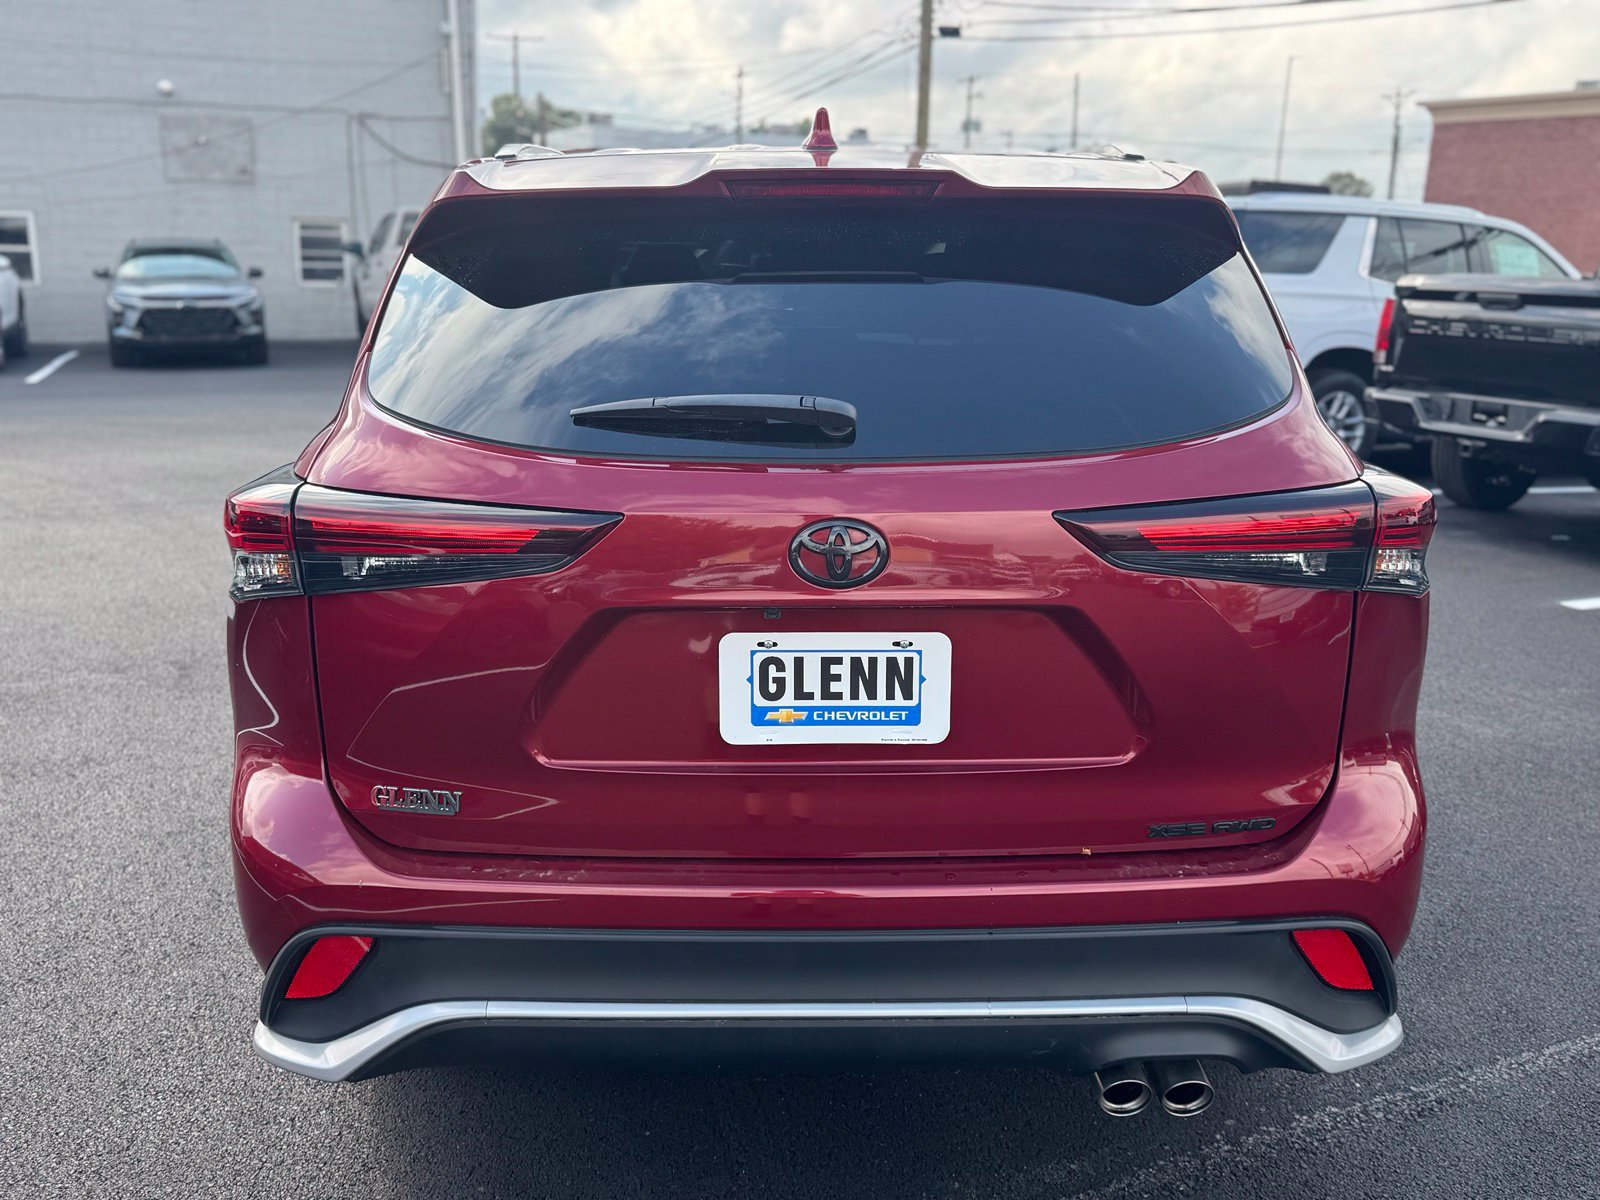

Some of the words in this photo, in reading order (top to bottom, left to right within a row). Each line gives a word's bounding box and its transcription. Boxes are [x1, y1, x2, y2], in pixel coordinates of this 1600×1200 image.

[758, 656, 914, 701] GLENN
[813, 711, 909, 721] CHEVROLET
[370, 785, 463, 815] GLENN
[1148, 823, 1206, 838] XSE
[1212, 817, 1276, 834] AWD
